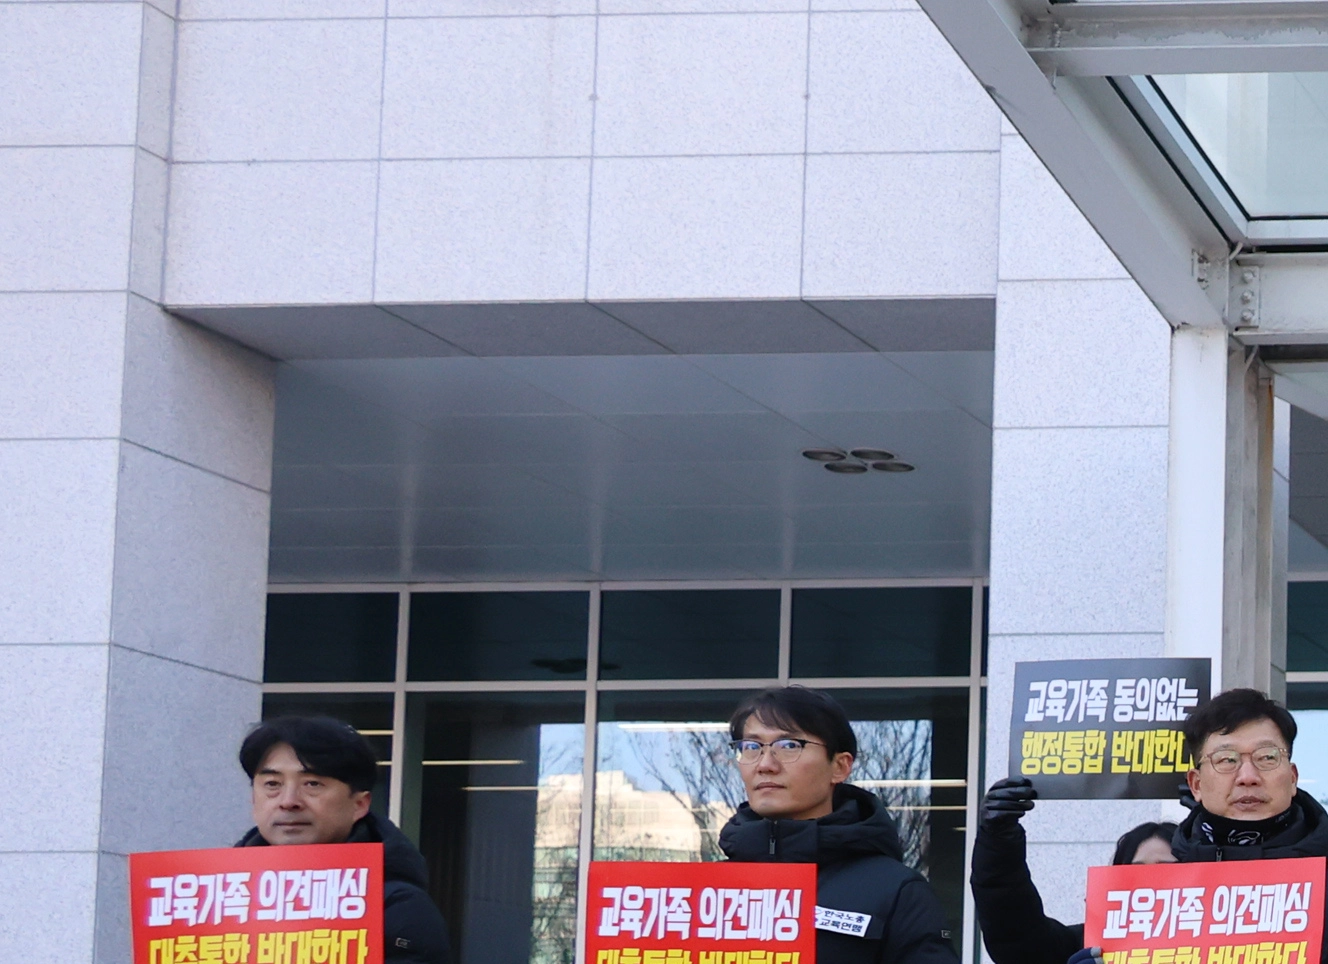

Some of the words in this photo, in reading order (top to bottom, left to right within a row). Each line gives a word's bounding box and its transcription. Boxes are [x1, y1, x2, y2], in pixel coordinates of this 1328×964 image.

[1024, 679, 1109, 723] 교육가족
[1113, 677, 1198, 722] 동의없는
[1023, 731, 1106, 774] 행정통합
[149, 872, 250, 926] 교육가족
[257, 868, 368, 922] 의견패싱
[599, 886, 691, 939] 교육가족
[698, 888, 801, 940] 의견패싱
[1103, 887, 1205, 940] 교육가족
[1212, 882, 1311, 936] 의견패싱
